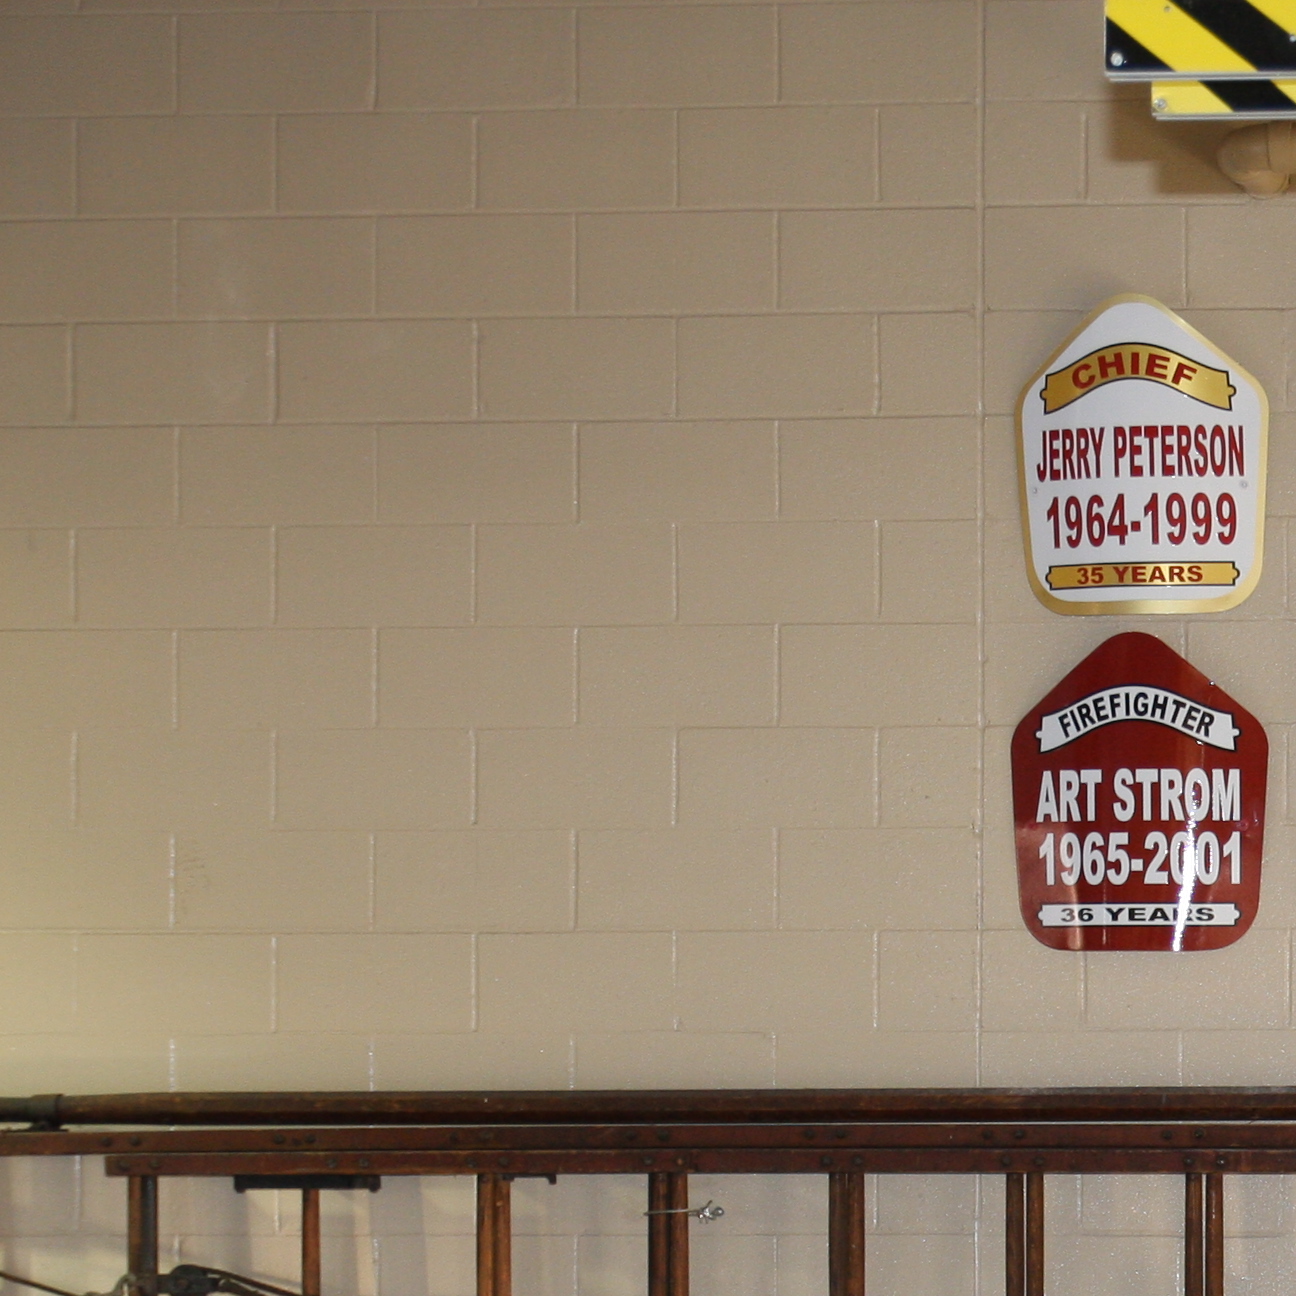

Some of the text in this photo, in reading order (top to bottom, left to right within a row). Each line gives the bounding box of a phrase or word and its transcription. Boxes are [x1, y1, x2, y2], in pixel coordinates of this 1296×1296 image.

[1071, 352, 1197, 389] CHIEF
[1037, 424, 1245, 482] JERRY PETERSON
[1047, 492, 1237, 549] 1964-1999
[1077, 565, 1204, 585] 35 YEARS
[1057, 691, 1215, 738] FIREFIGHTER
[1036, 767, 1240, 822] ART STROM
[1038, 831, 1241, 886] 1965-2001
[1060, 907, 1093, 922] 36
